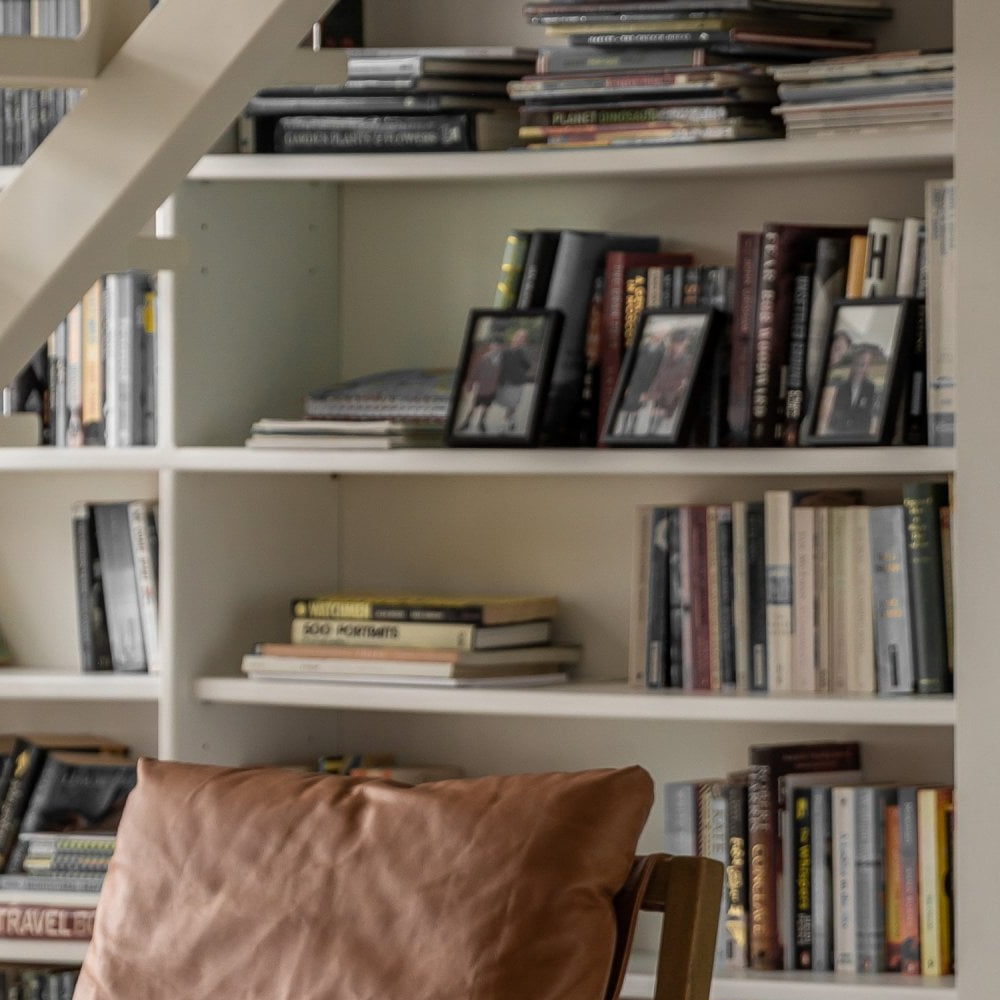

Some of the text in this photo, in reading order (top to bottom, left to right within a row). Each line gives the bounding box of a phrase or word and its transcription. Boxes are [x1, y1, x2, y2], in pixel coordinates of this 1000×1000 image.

[552, 110, 597, 125] PLANET
[753, 326, 772, 417] WOODWARD
[336, 623, 399, 640] PORTRAITS
[750, 844, 765, 934] CONCLAVE
